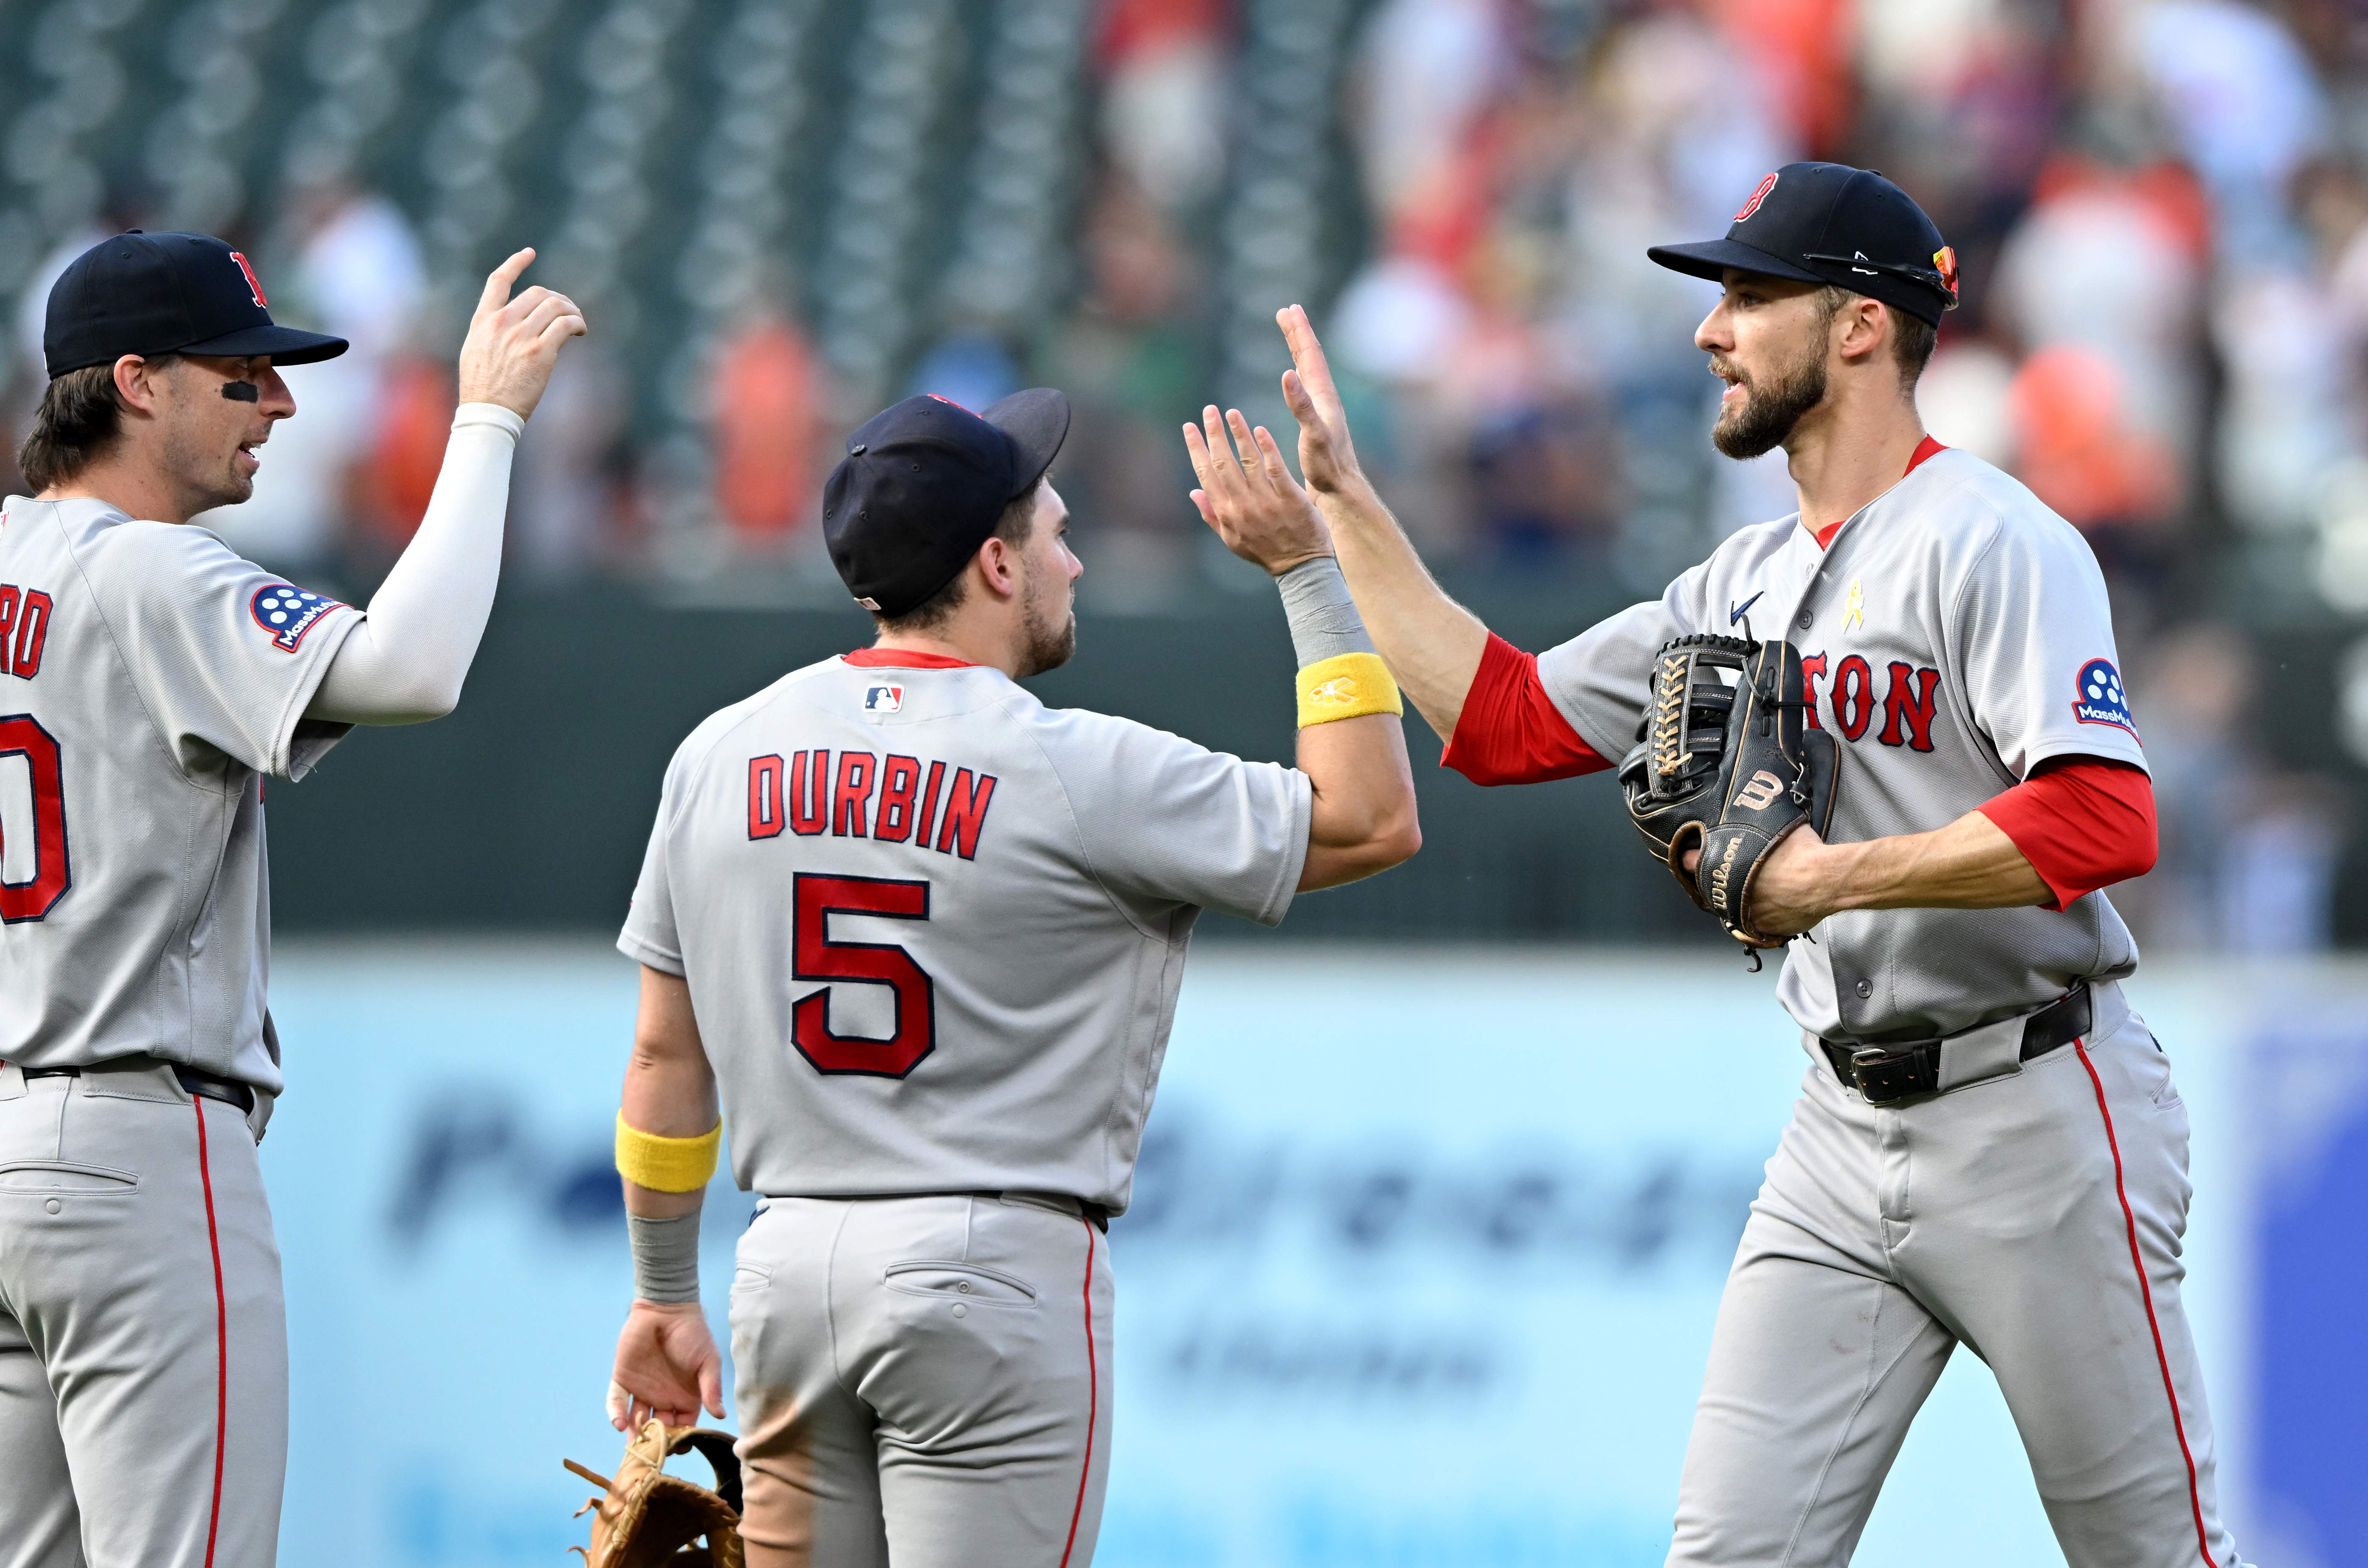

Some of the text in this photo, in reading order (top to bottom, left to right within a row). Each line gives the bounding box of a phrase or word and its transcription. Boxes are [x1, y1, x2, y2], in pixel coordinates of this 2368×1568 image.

[1733, 172, 1779, 222] B
[748, 749, 997, 861] DURBIN
[1712, 837, 1743, 910] Wilson
[791, 872, 936, 1079] 5
